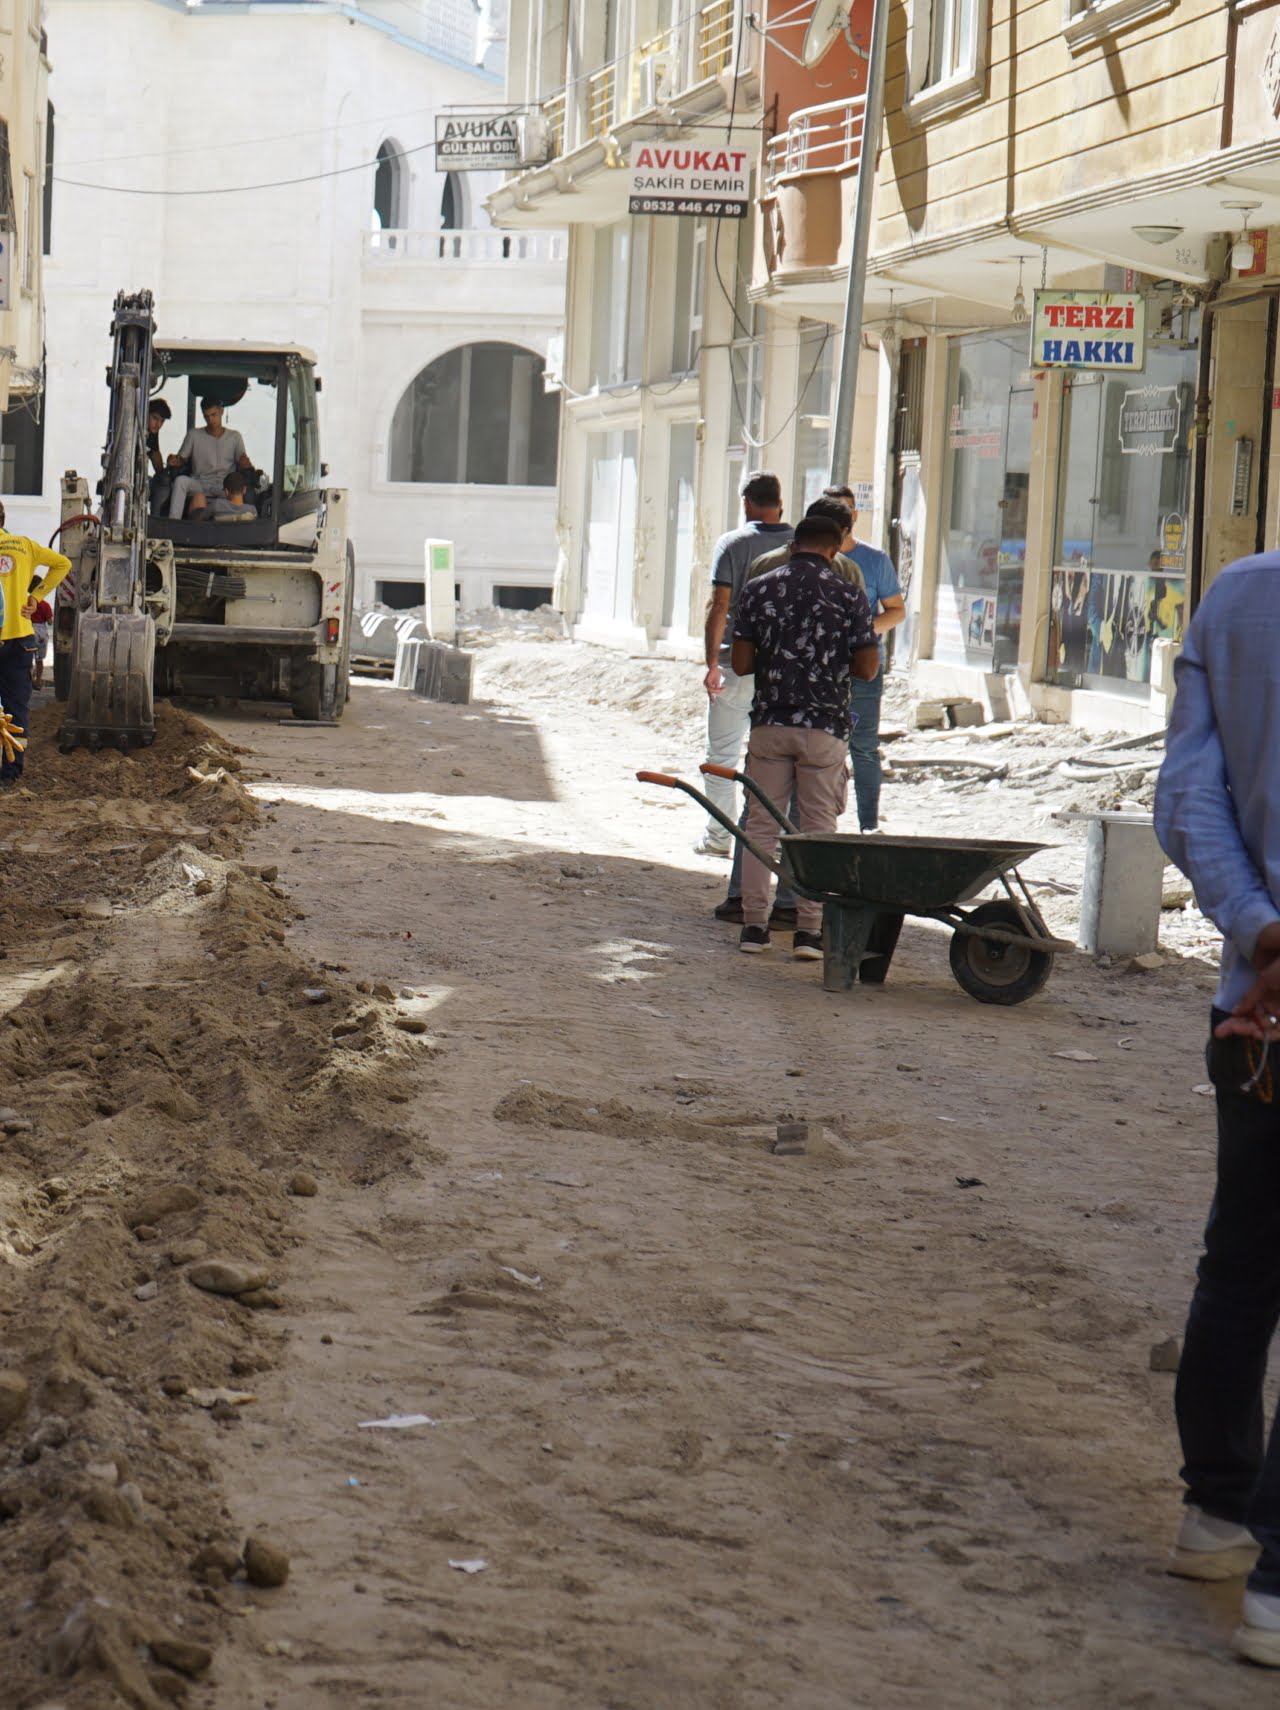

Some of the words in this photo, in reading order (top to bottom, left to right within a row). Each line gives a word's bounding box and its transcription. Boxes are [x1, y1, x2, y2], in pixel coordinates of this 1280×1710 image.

[442, 141, 490, 155] GÜLŞAH
[636, 148, 747, 172] AVUKAT
[634, 174, 685, 192] ŞAKİR
[690, 176, 745, 192] DEMİR
[643, 200, 675, 212] 0532
[678, 202, 702, 213] 446
[705, 203, 722, 214] 47
[725, 204, 741, 215] 99
[1044, 301, 1135, 329] TERZİ
[1043, 340, 1134, 363] HAKKI
